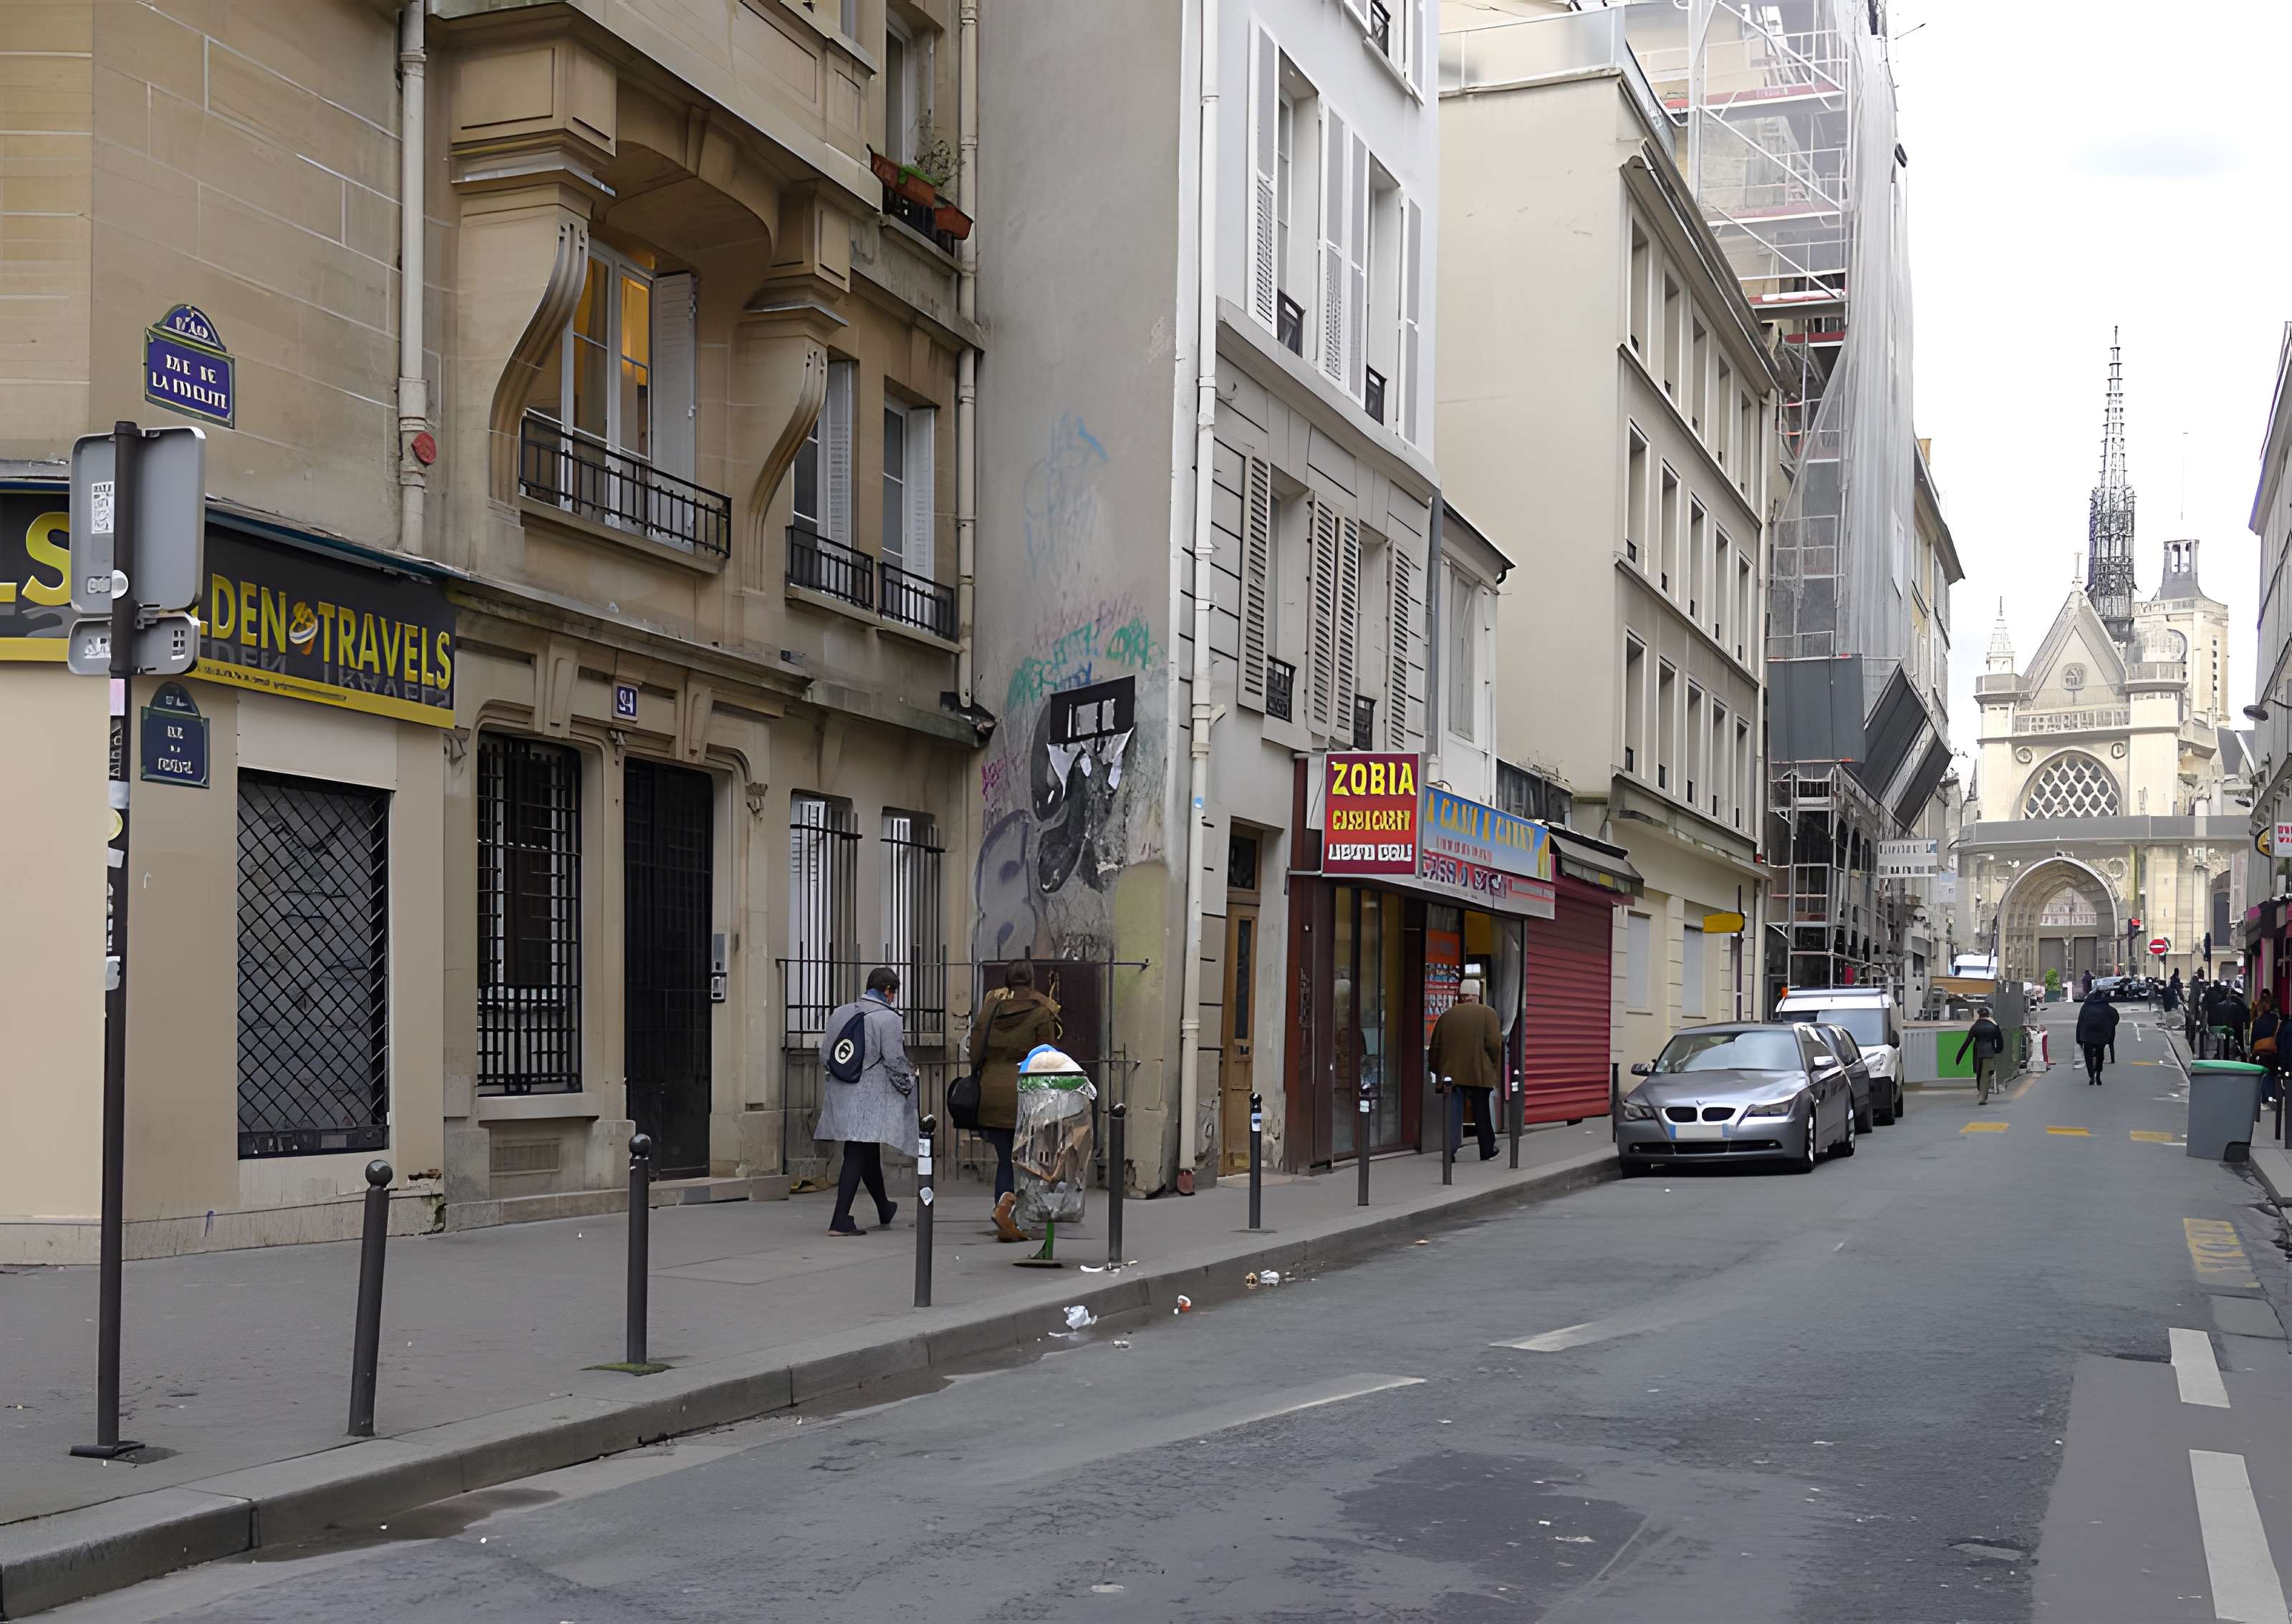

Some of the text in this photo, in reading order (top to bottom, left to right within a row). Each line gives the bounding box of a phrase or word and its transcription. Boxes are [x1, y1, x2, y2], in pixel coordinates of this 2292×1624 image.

[200, 573, 286, 653] DEN
[318, 601, 451, 691] TRAVELS
[1332, 761, 1416, 796] ZOBIA
